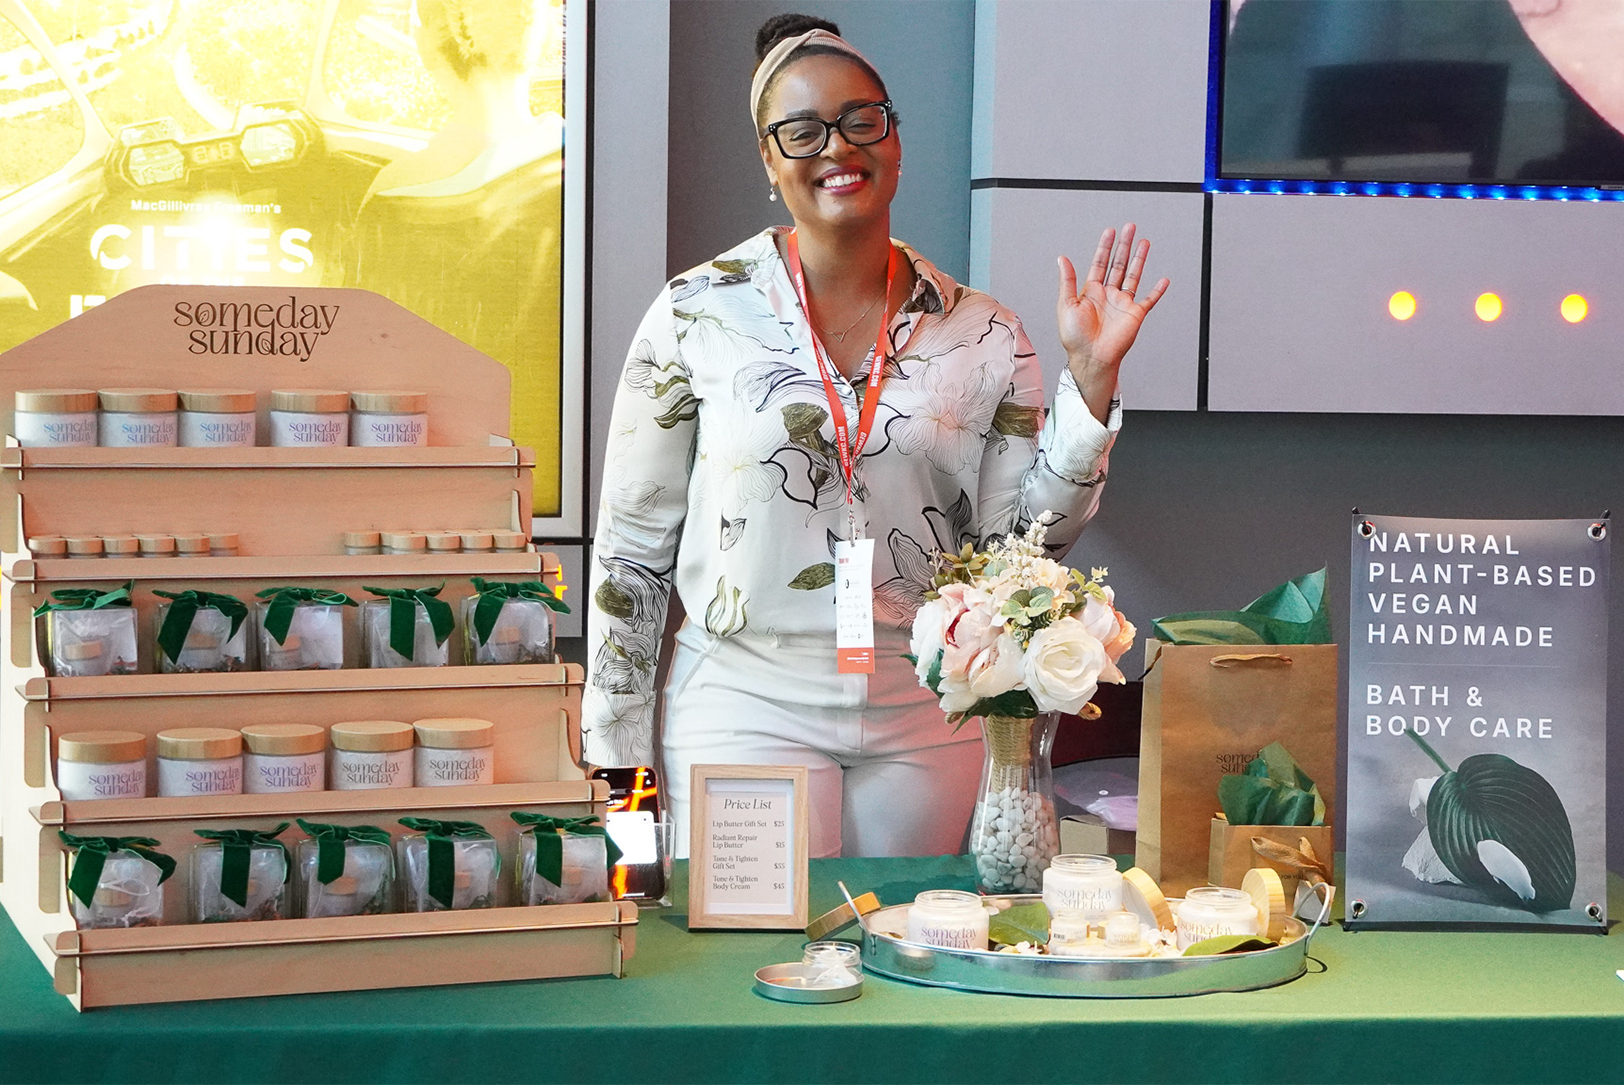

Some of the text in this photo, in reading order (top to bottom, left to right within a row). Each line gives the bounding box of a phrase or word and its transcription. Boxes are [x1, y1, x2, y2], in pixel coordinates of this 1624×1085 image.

[90, 224, 314, 273] CITIES
[173, 296, 340, 335] someday
[188, 325, 320, 362] sunday
[288, 421, 344, 434] someday
[371, 421, 423, 435] someday
[293, 431, 337, 444] sunday
[376, 431, 418, 444] sunday
[1369, 532, 1519, 555] NATURAL
[1369, 562, 1596, 587] PLANT-BASED
[1368, 593, 1477, 615] VEGAN
[1368, 623, 1553, 647] HANDMADE
[1366, 684, 1483, 707] BATH &
[1366, 715, 1553, 739] BODY CARE
[260, 762, 317, 777] someday
[342, 760, 402, 775] someday
[429, 757, 487, 772] someday
[185, 766, 240, 781] someday
[346, 771, 396, 785] sunday
[434, 768, 482, 782] sunday
[191, 778, 236, 792] sunday
[265, 774, 311, 788] sunday
[723, 798, 772, 810] Price List
[723, 820, 743, 828] Butter
[744, 820, 757, 828] Gift
[757, 820, 767, 828] Set
[737, 834, 758, 842] Repair
[1057, 888, 1112, 902] someday
[1061, 898, 1106, 912] sunday
[921, 927, 978, 940] someday
